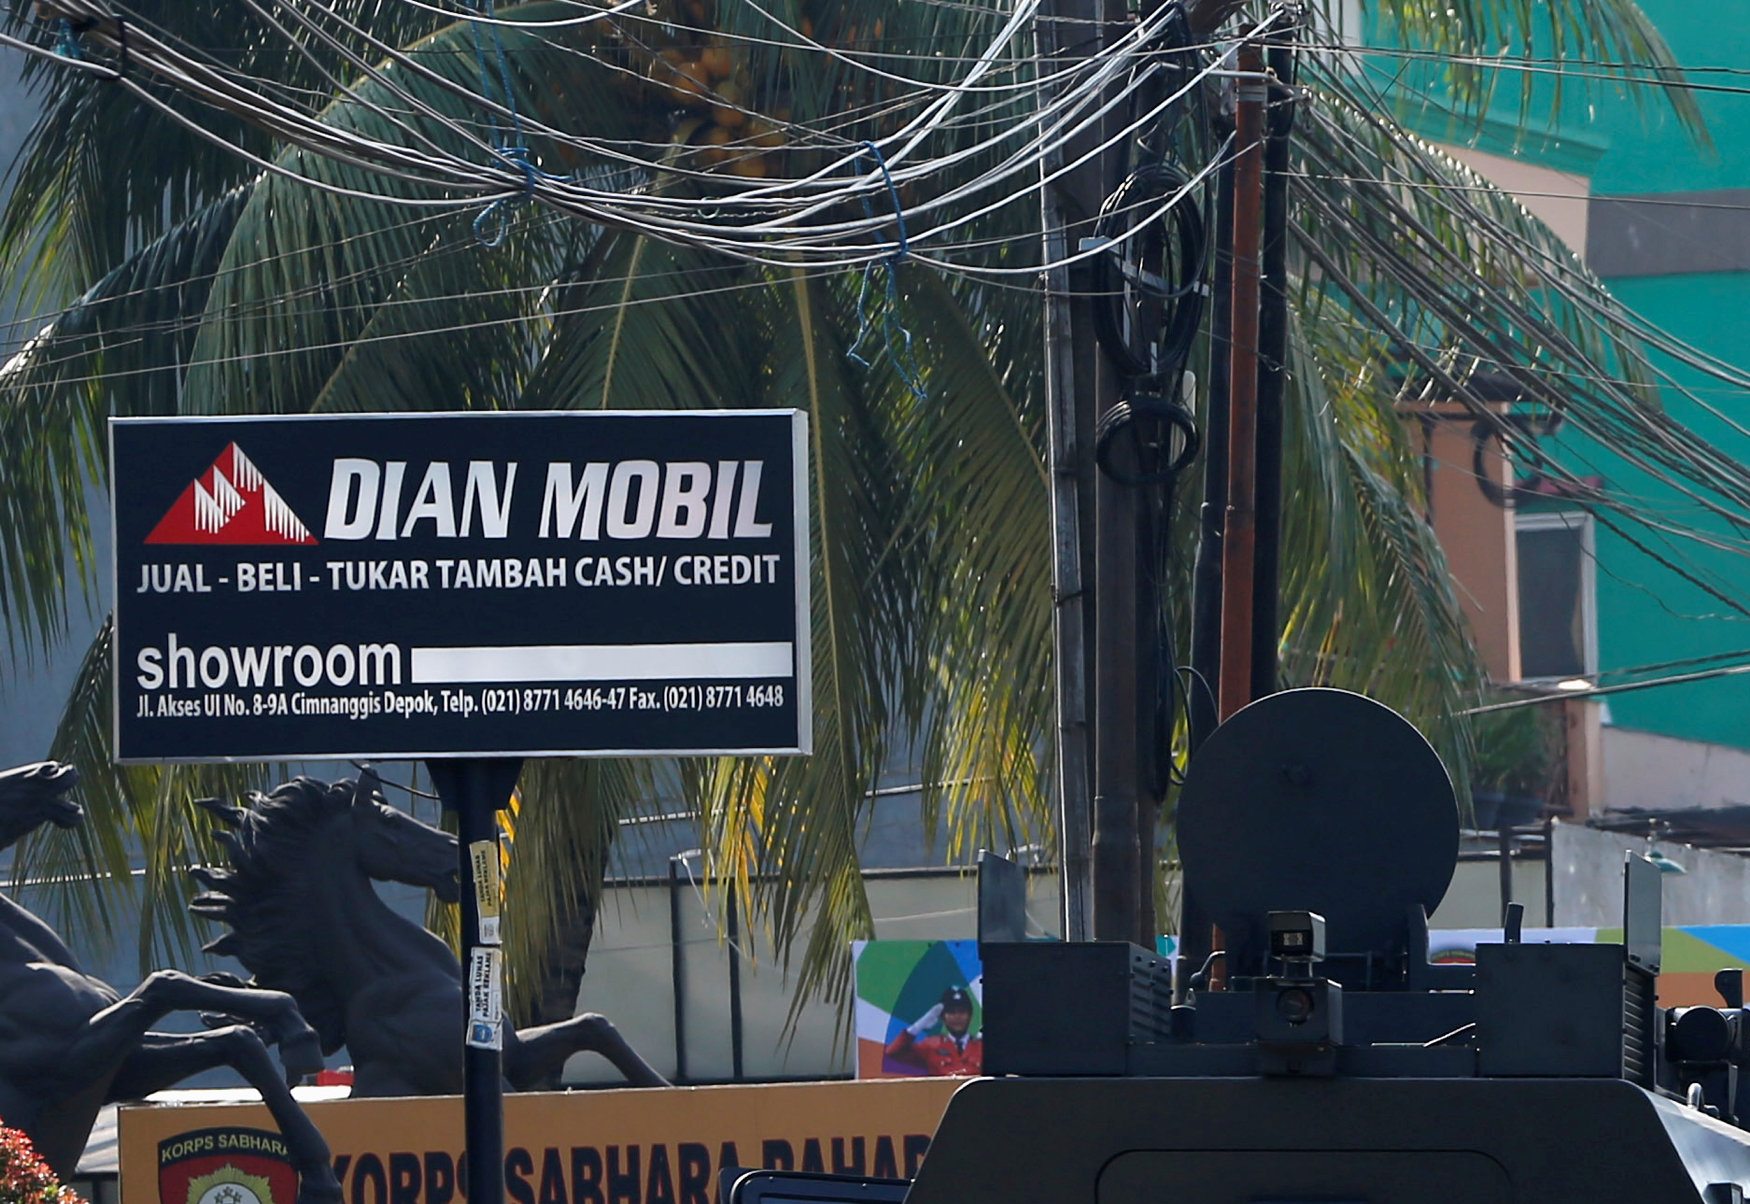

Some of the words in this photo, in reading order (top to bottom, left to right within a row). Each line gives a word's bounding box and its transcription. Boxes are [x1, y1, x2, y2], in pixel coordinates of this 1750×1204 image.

[323, 457, 518, 541] DIAN
[538, 459, 774, 541] MOBIL
[136, 562, 211, 593] JUAL
[237, 561, 301, 592] BELI
[327, 560, 429, 591] TUKAR
[436, 558, 567, 589] TAMBAH
[574, 556, 665, 588] CASH/
[673, 554, 781, 586] CREDIT
[136, 632, 402, 690] showroom
[157, 694, 201, 717] Akses
[224, 693, 250, 716] No.
[253, 693, 289, 716] 8-9A
[291, 691, 381, 720] Cimnanggis
[384, 690, 438, 719] Depok,
[441, 689, 478, 717] Telp.
[482, 688, 521, 715] (021)
[523, 688, 560, 711] 8771
[564, 687, 626, 710] 4646-47
[629, 687, 660, 710] Fax.
[664, 686, 703, 712] (021)
[706, 686, 742, 709] 8771
[746, 685, 784, 708] 4648
[475, 955, 483, 981] LUNAS
[162, 1136, 214, 1163] KORPS
